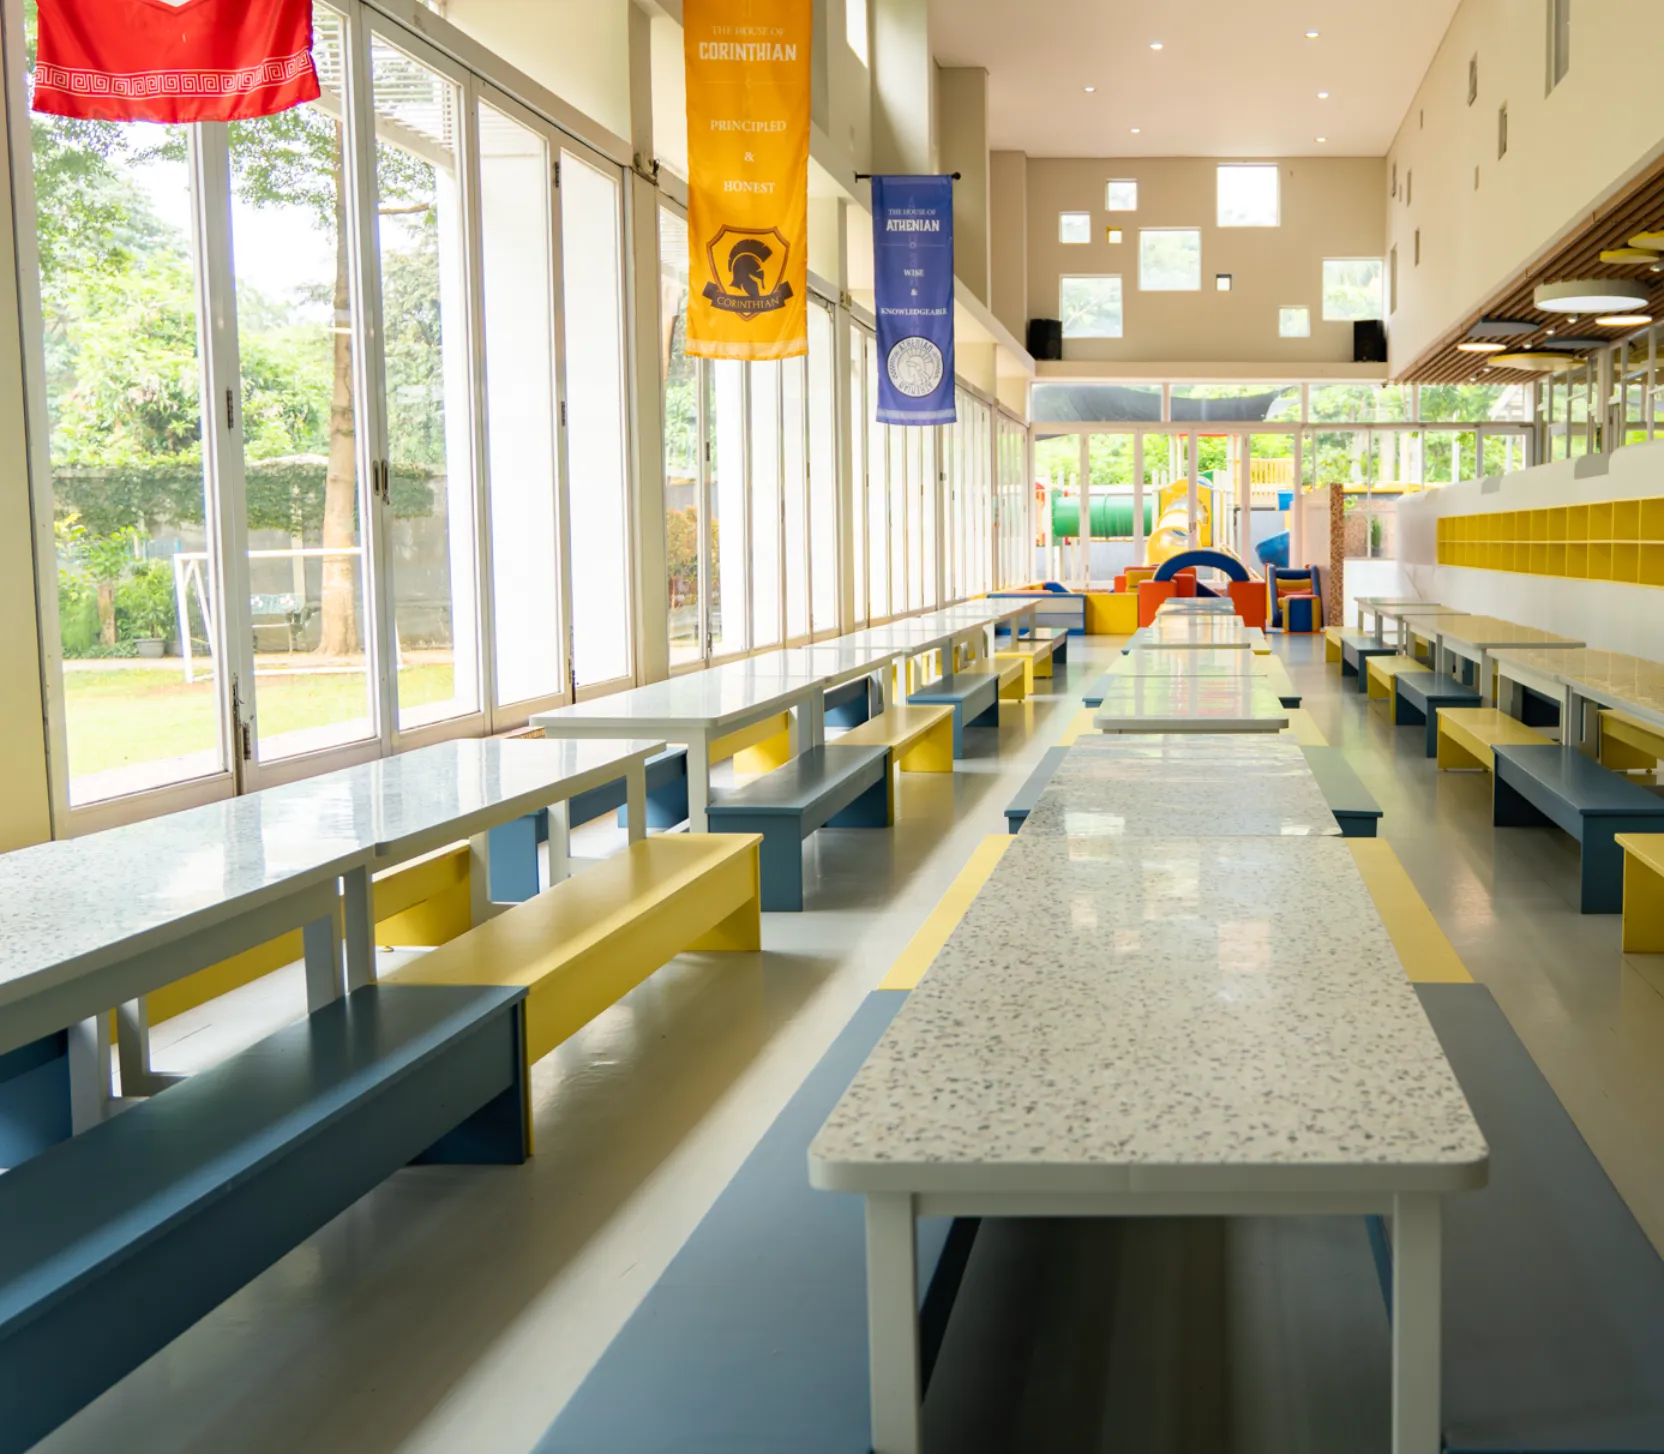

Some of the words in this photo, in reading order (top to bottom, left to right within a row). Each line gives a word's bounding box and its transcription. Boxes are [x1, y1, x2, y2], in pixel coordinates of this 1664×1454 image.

[711, 26, 732, 36] THE
[735, 26, 767, 36] HOUSE
[770, 27, 785, 36] OF
[699, 42, 797, 61] CORINTHIAN
[710, 120, 787, 132] PRINCIPLED
[744, 151, 755, 162] &
[723, 180, 775, 193] HONEST
[886, 219, 940, 231] ATHENIAN
[911, 288, 918, 296] &
[716, 296, 780, 309] CORINTHIAN
[881, 307, 948, 316] KNOWLEDGEABLE
